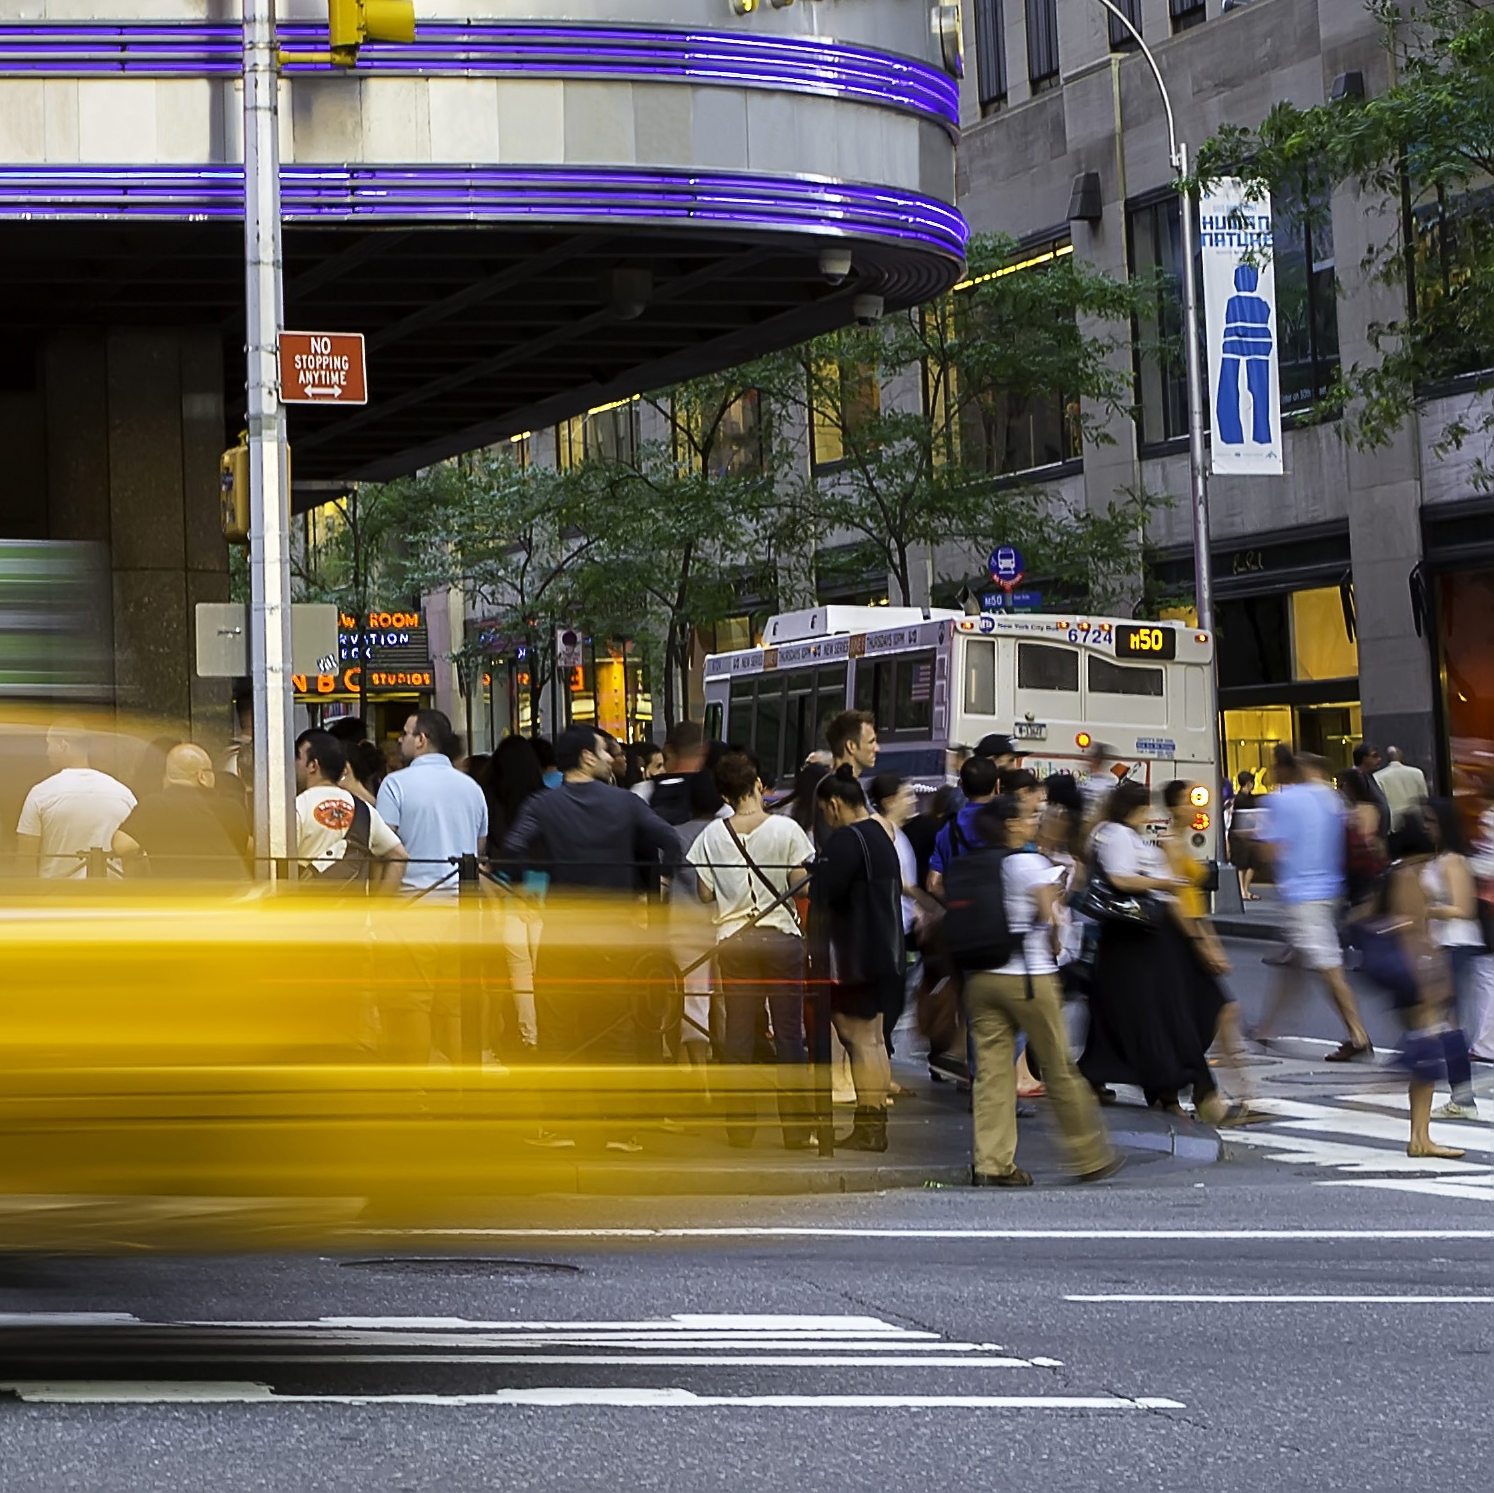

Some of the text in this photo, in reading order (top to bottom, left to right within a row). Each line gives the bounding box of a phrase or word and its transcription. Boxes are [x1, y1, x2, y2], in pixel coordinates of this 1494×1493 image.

[310, 336, 331, 355] NO
[294, 354, 349, 371] STOPPING
[298, 370, 347, 385] ANYTIME
[369, 611, 419, 628] ROOM
[1067, 628, 1114, 646] 6724
[1129, 627, 1164, 652] M50
[371, 672, 431, 686] STUDIOS
